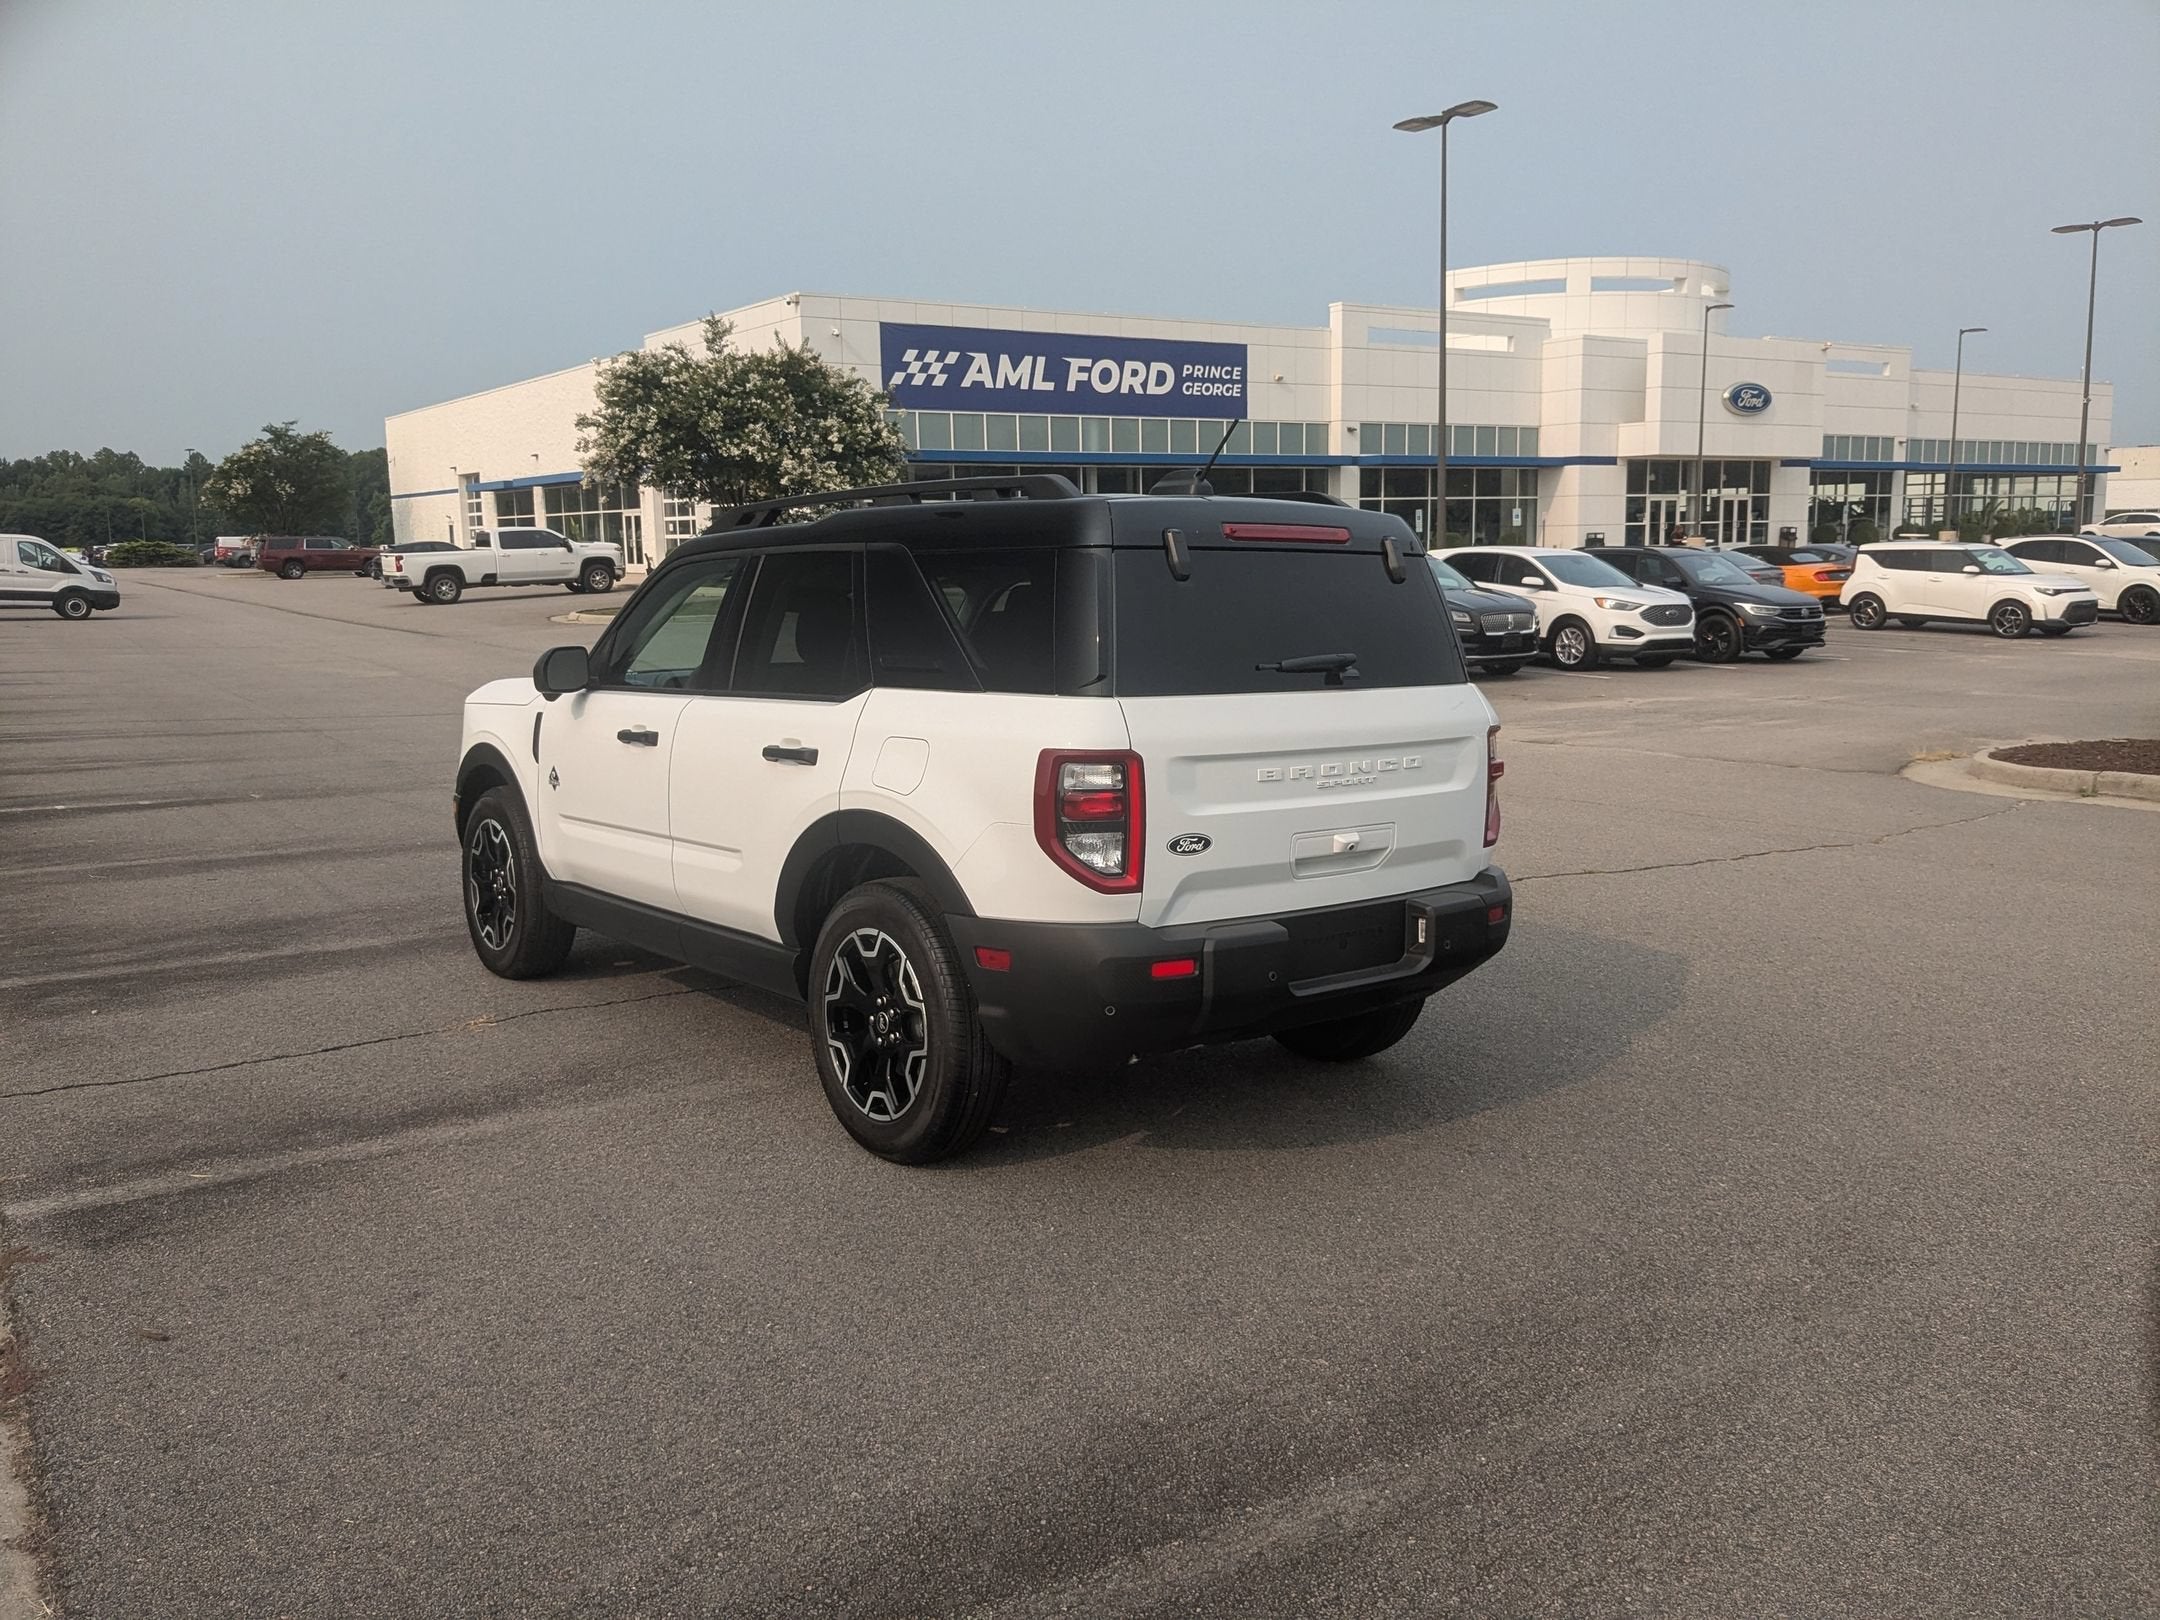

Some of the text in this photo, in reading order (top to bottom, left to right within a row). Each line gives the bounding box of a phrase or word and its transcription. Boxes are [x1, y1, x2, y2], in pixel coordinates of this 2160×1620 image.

[960, 352, 1175, 395] AML FORD
[1182, 364, 1242, 380] PRINCE
[1182, 381, 1242, 397] GEORGE
[1738, 389, 1766, 407] Ford
[1257, 756, 1423, 782] BRONCO
[1316, 775, 1377, 789] SPORT
[1176, 837, 1205, 852] Ford
